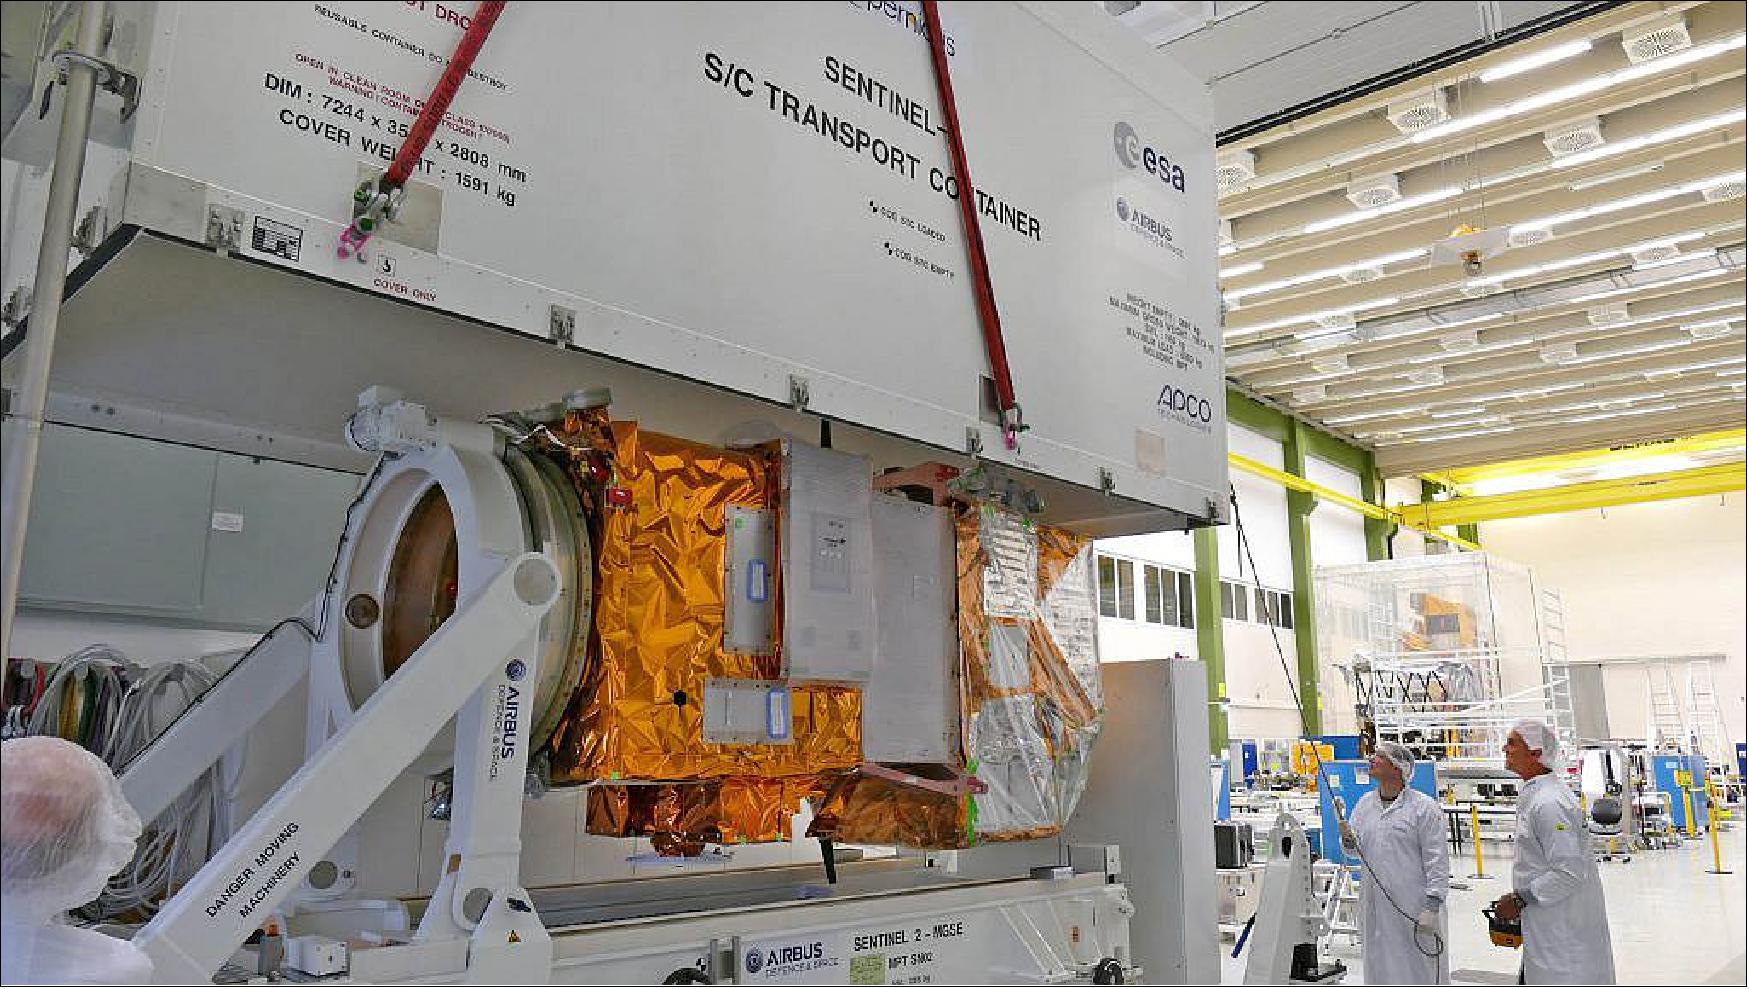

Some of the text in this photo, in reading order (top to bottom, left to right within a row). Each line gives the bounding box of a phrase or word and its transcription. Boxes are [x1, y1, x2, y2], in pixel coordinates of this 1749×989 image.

[436, 4, 471, 31] DRO
[264, 72, 302, 99] DIM
[322, 93, 365, 123] 7244
[498, 163, 527, 183] mm
[824, 55, 950, 137] SENTINEL-
[279, 108, 351, 147] COVER
[361, 135, 436, 175] WEIT
[455, 171, 489, 195] 1591
[496, 184, 516, 207] kg
[704, 53, 755, 98] S/C
[763, 80, 921, 181] TRANSPORT
[928, 166, 1042, 242] COTAINER
[1142, 146, 1186, 193] esa
[1131, 208, 1173, 242] AIRBUS
[373, 277, 408, 296] COVER
[502, 686, 520, 759] AIRBUS
[204, 822, 300, 918] DANGER MOVING
[239, 850, 300, 918] MACHINERY
[766, 941, 823, 967] AIRBUS
[853, 929, 909, 952] SENTINEL
[913, 927, 923, 942] 2
